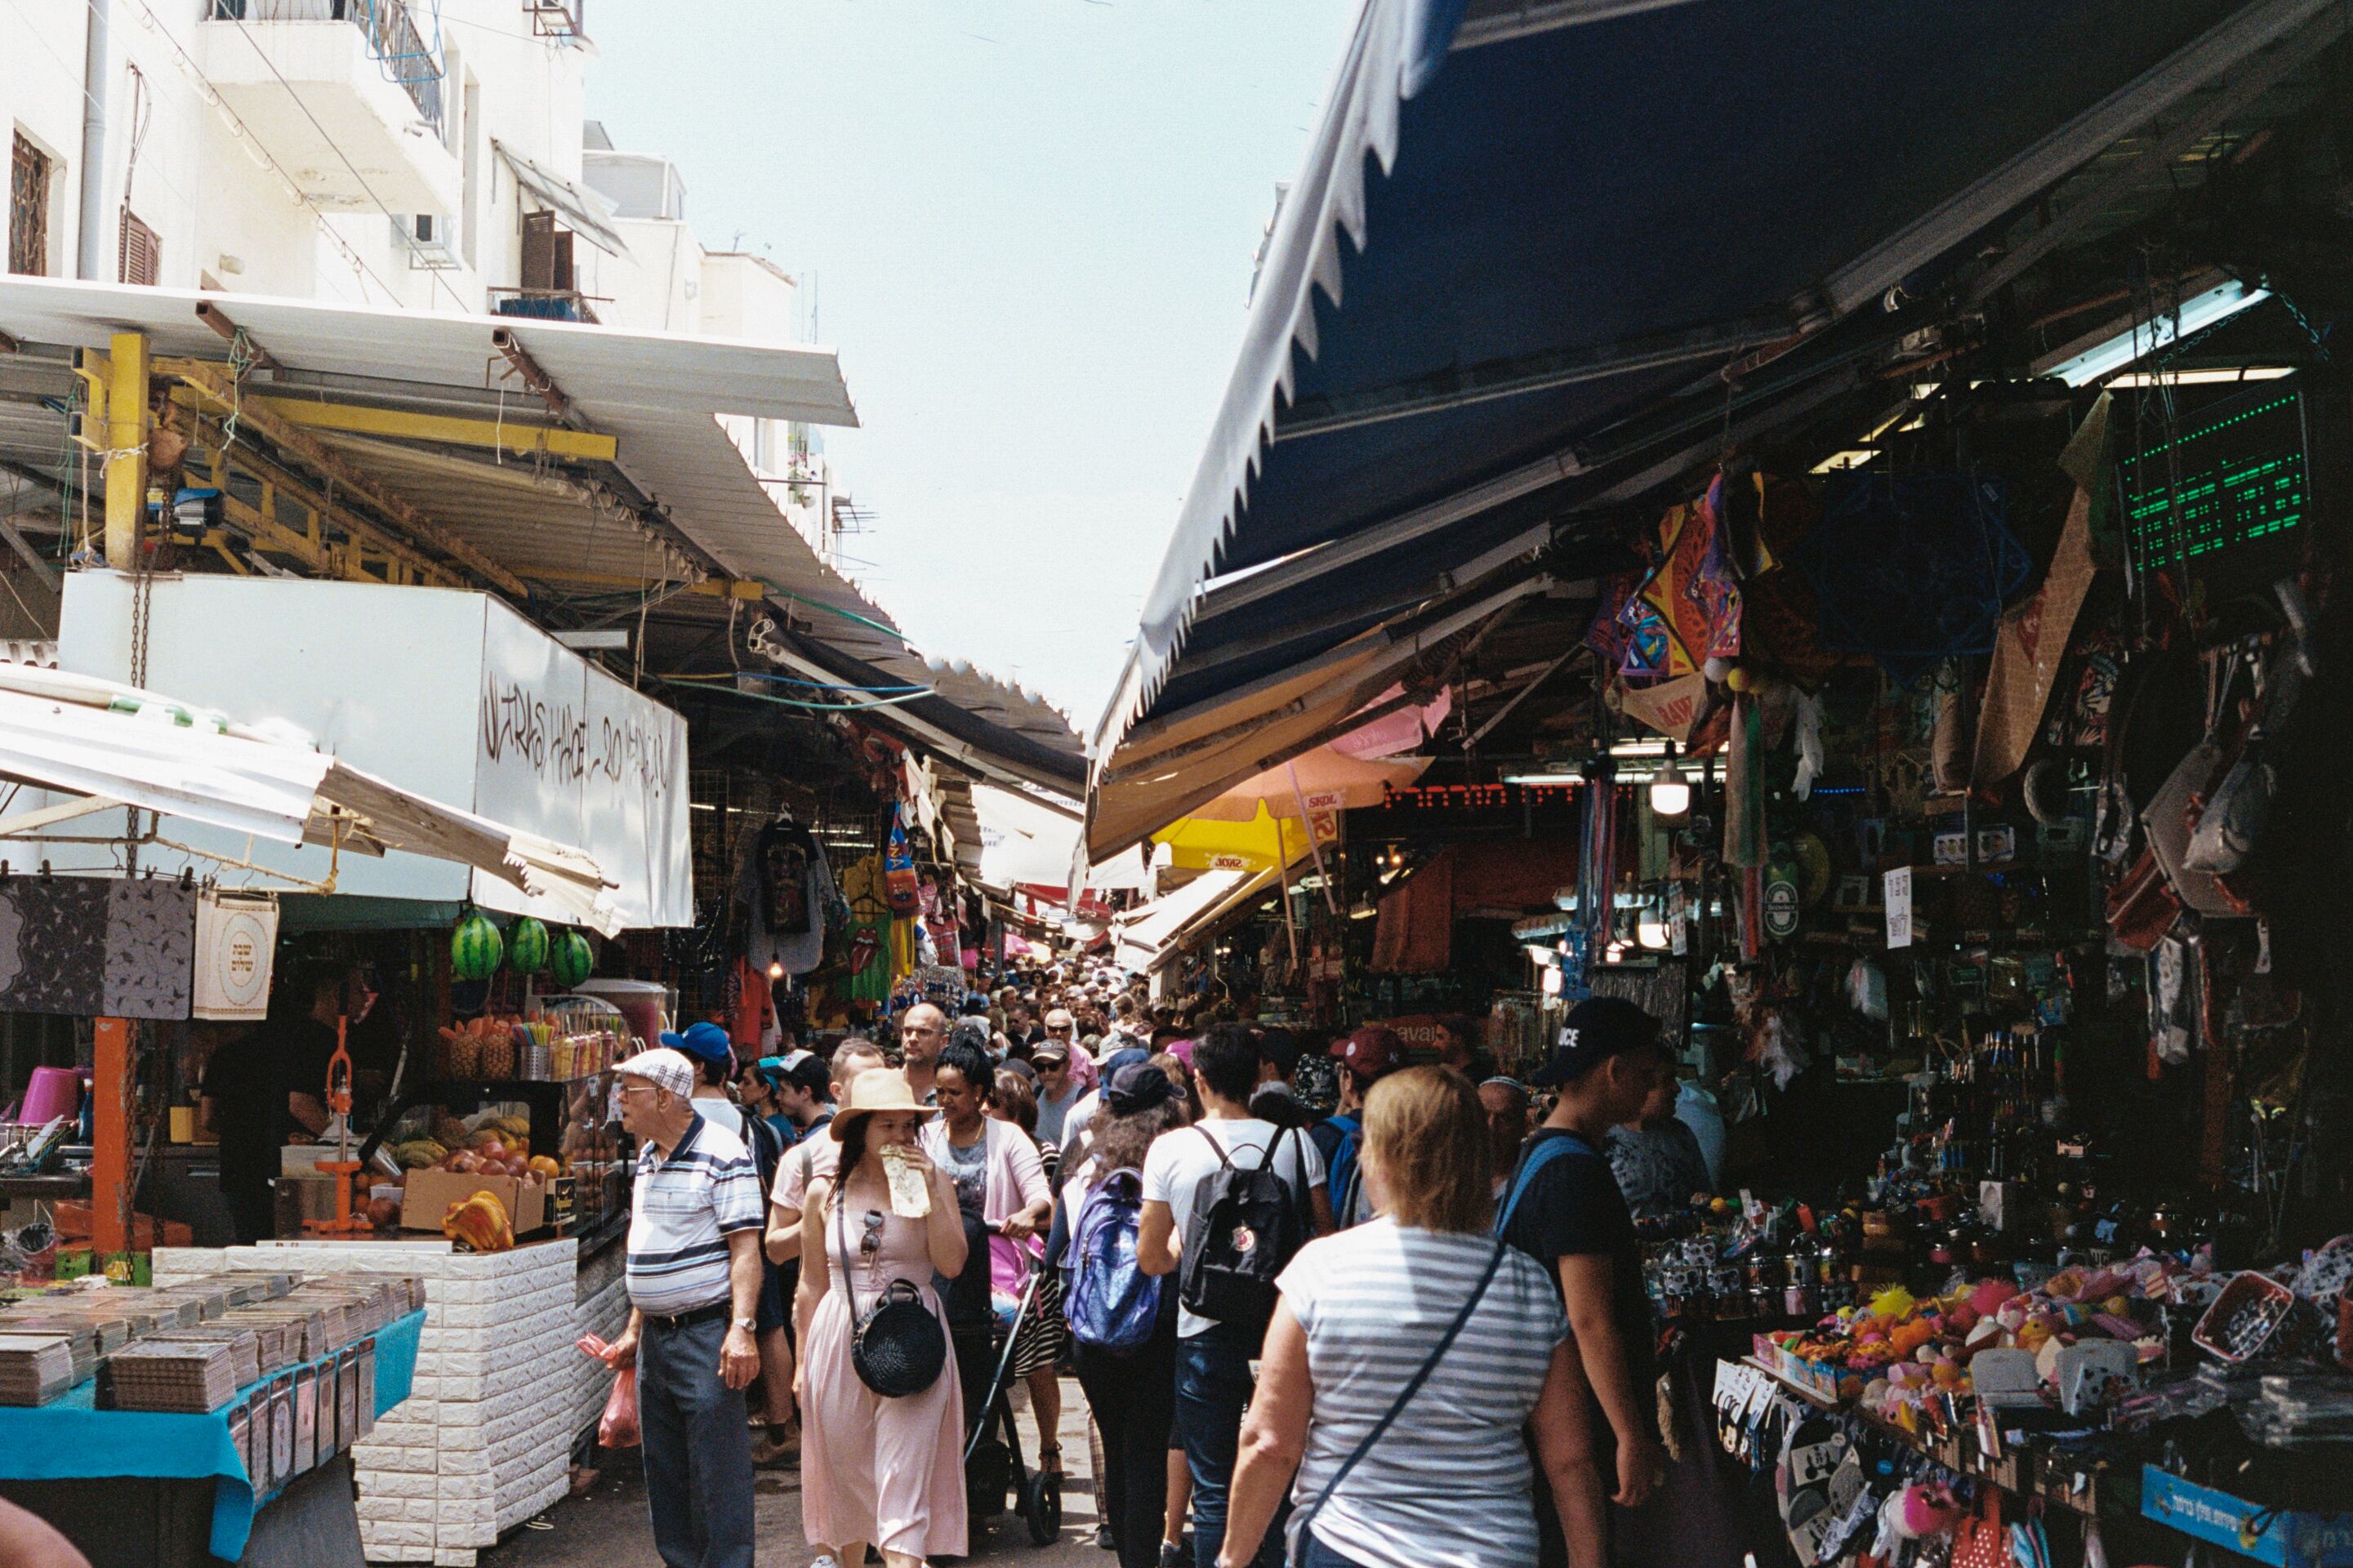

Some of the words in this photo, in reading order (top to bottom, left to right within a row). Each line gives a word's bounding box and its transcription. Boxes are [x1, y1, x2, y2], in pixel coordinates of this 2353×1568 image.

[1308, 795, 1337, 808] SKOL
[233, 944, 252, 956] שבת
[231, 960, 253, 971] שלום
